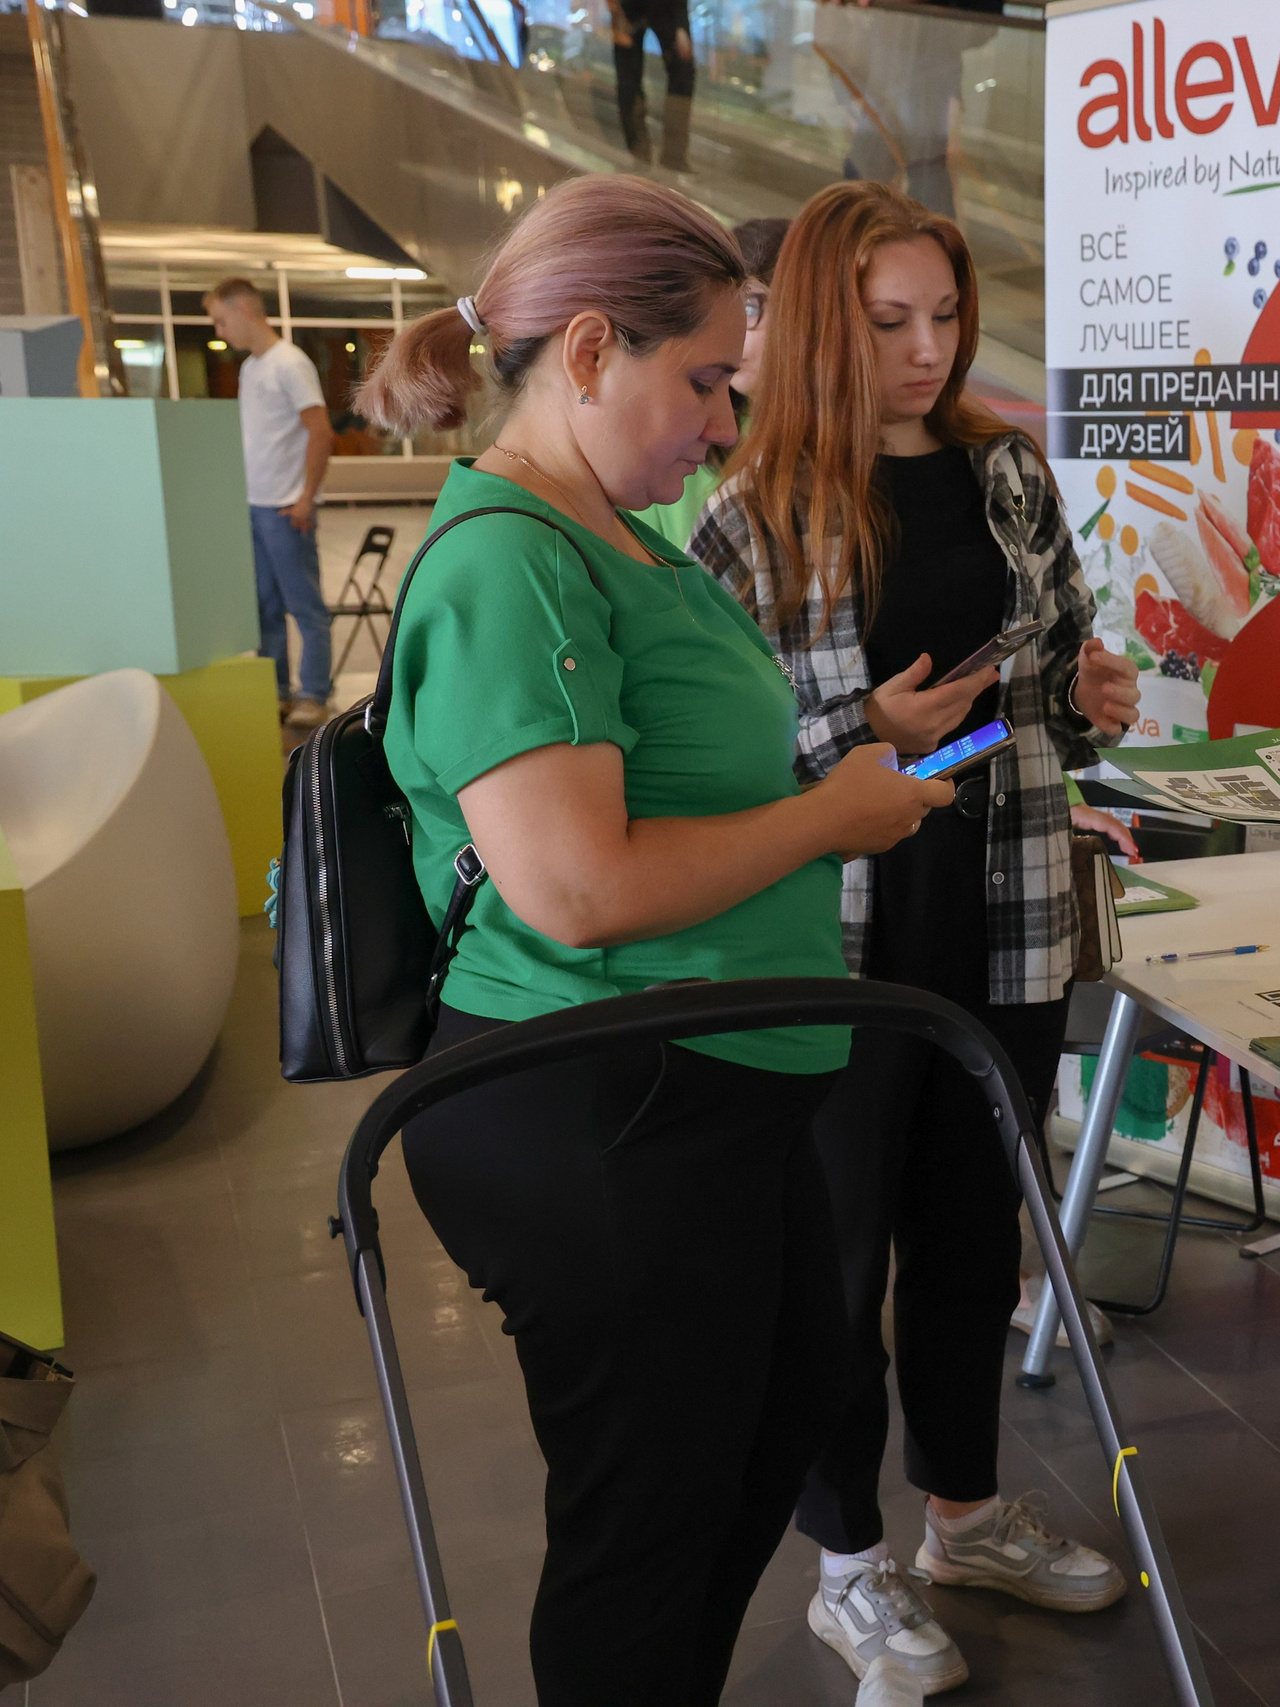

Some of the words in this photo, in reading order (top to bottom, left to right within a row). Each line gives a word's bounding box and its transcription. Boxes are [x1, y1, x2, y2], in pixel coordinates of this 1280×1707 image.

[1104, 155, 1187, 199] Inspired
[1194, 154, 1220, 193] by
[1080, 224, 1128, 262] ВСЁ
[1080, 274, 1173, 307] САМОЕ
[1079, 320, 1191, 353] ЛУЧШЕЕ
[1079, 372, 1134, 409] ДЛЯ
[1079, 417, 1184, 457] ДРУЗЕЙ
